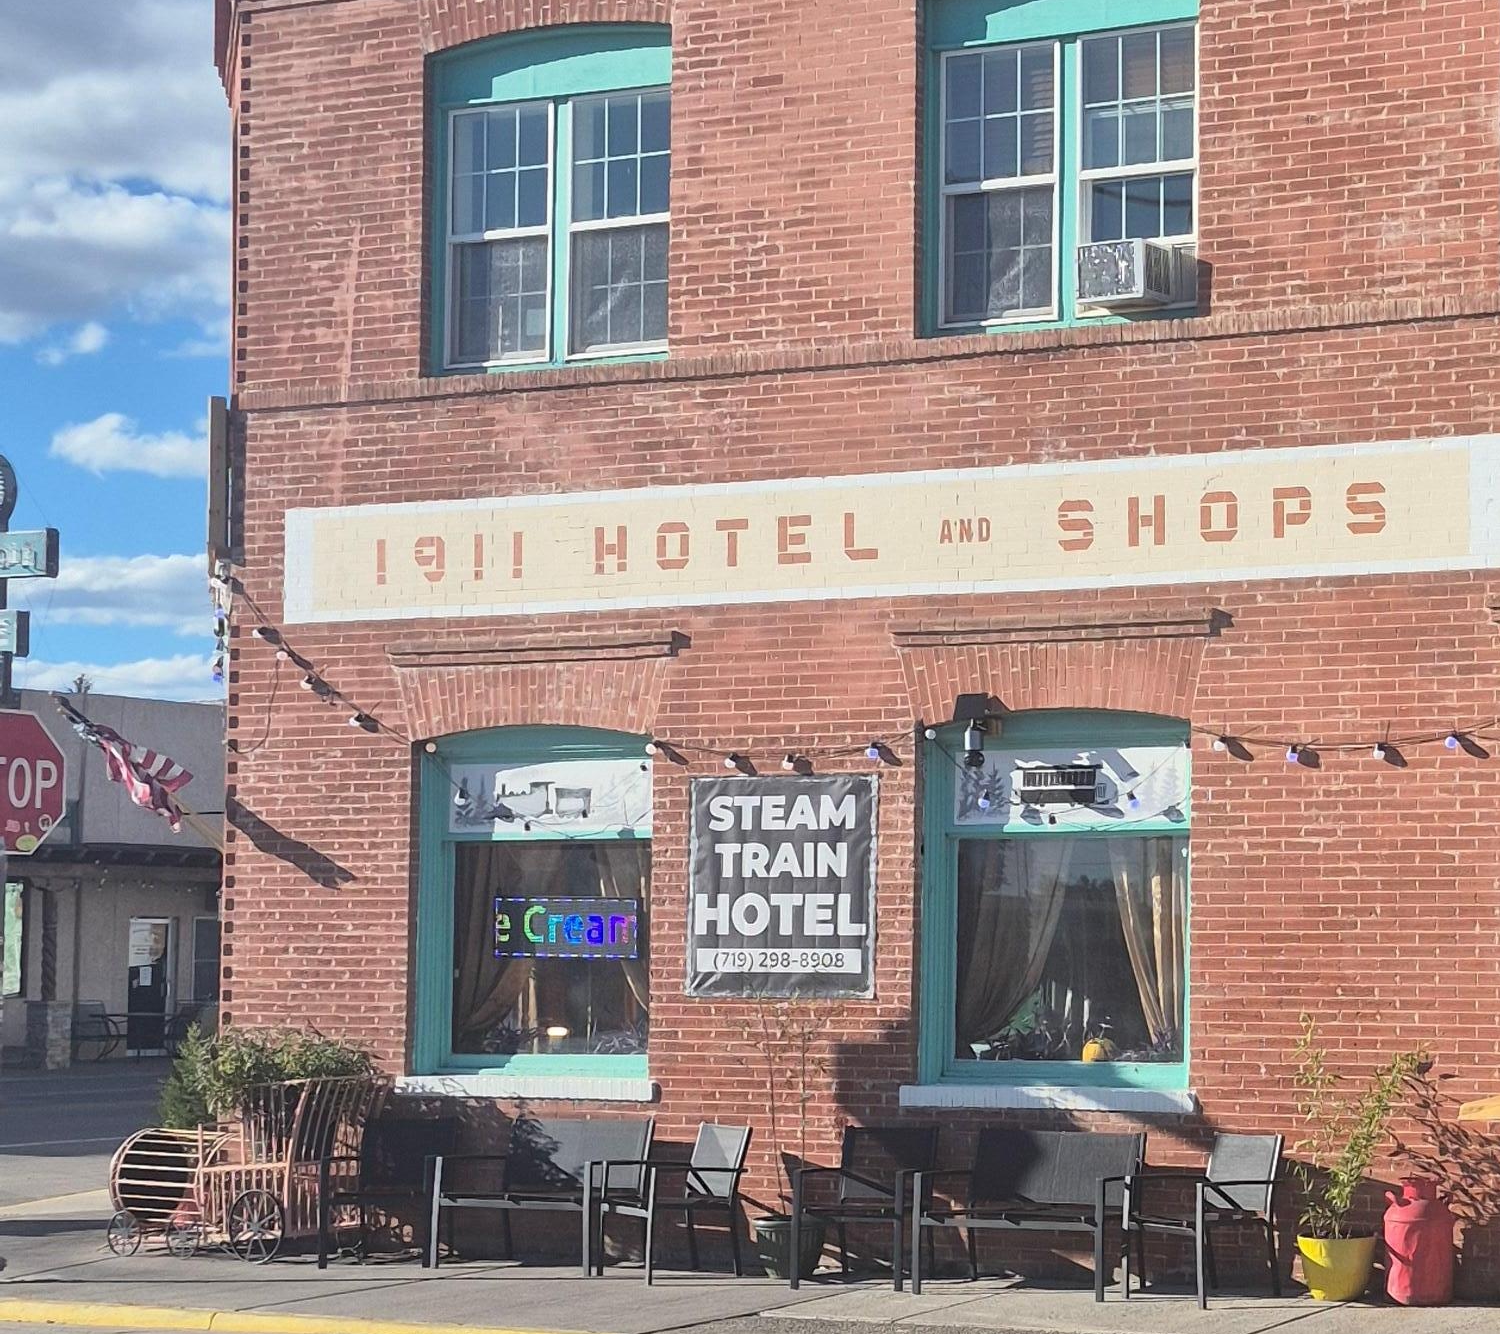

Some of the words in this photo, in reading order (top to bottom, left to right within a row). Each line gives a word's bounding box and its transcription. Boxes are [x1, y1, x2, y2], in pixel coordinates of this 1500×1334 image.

[376, 531, 523, 585] 1911
[594, 512, 879, 575] HOTEL
[939, 516, 992, 544] AND
[1057, 482, 1386, 551] SHOPS
[0, 757, 58, 809] OP
[708, 794, 856, 832] STEAM
[714, 842, 848, 878] TRAIN
[694, 892, 867, 937] HOTEL
[713, 951, 754, 971] (719)
[758, 951, 845, 969] 298-8908
